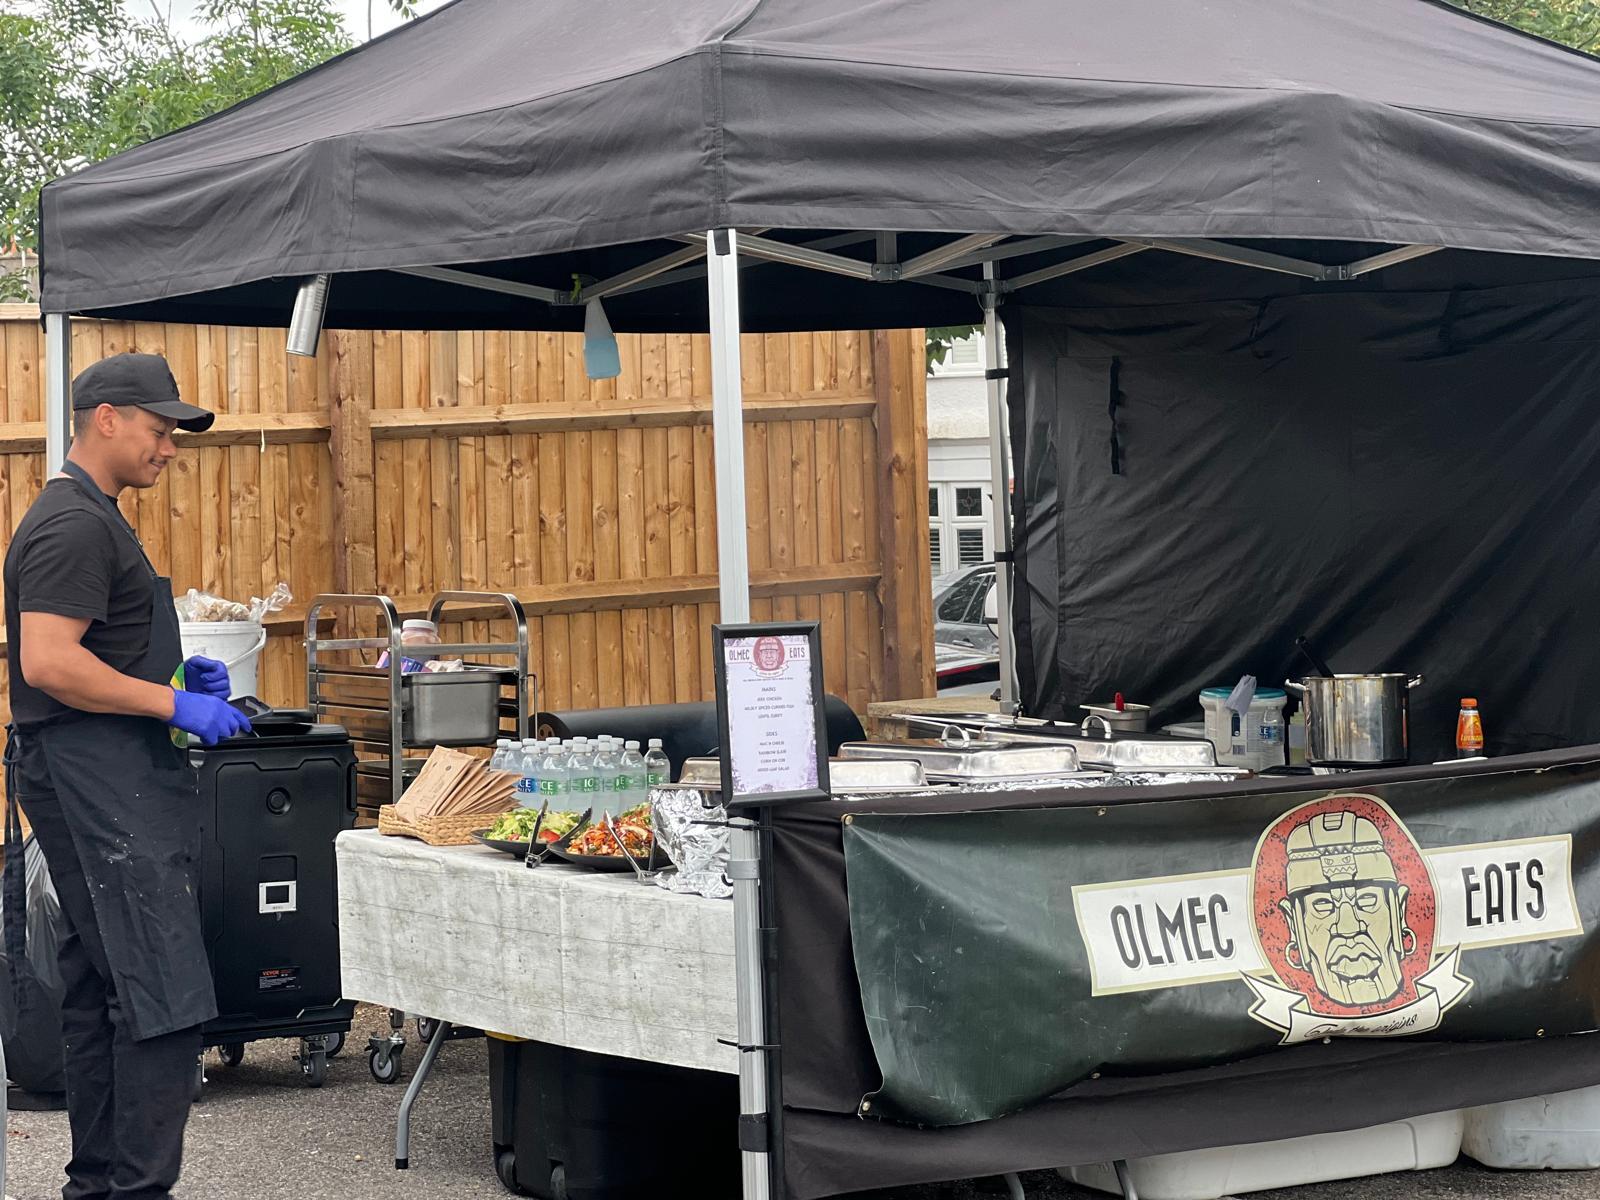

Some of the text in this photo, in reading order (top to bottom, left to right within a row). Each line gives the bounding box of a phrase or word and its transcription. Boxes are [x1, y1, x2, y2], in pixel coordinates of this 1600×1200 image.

[728, 647, 805, 661] OLMEC EATS
[1110, 858, 1546, 969] OLMEC EATS
